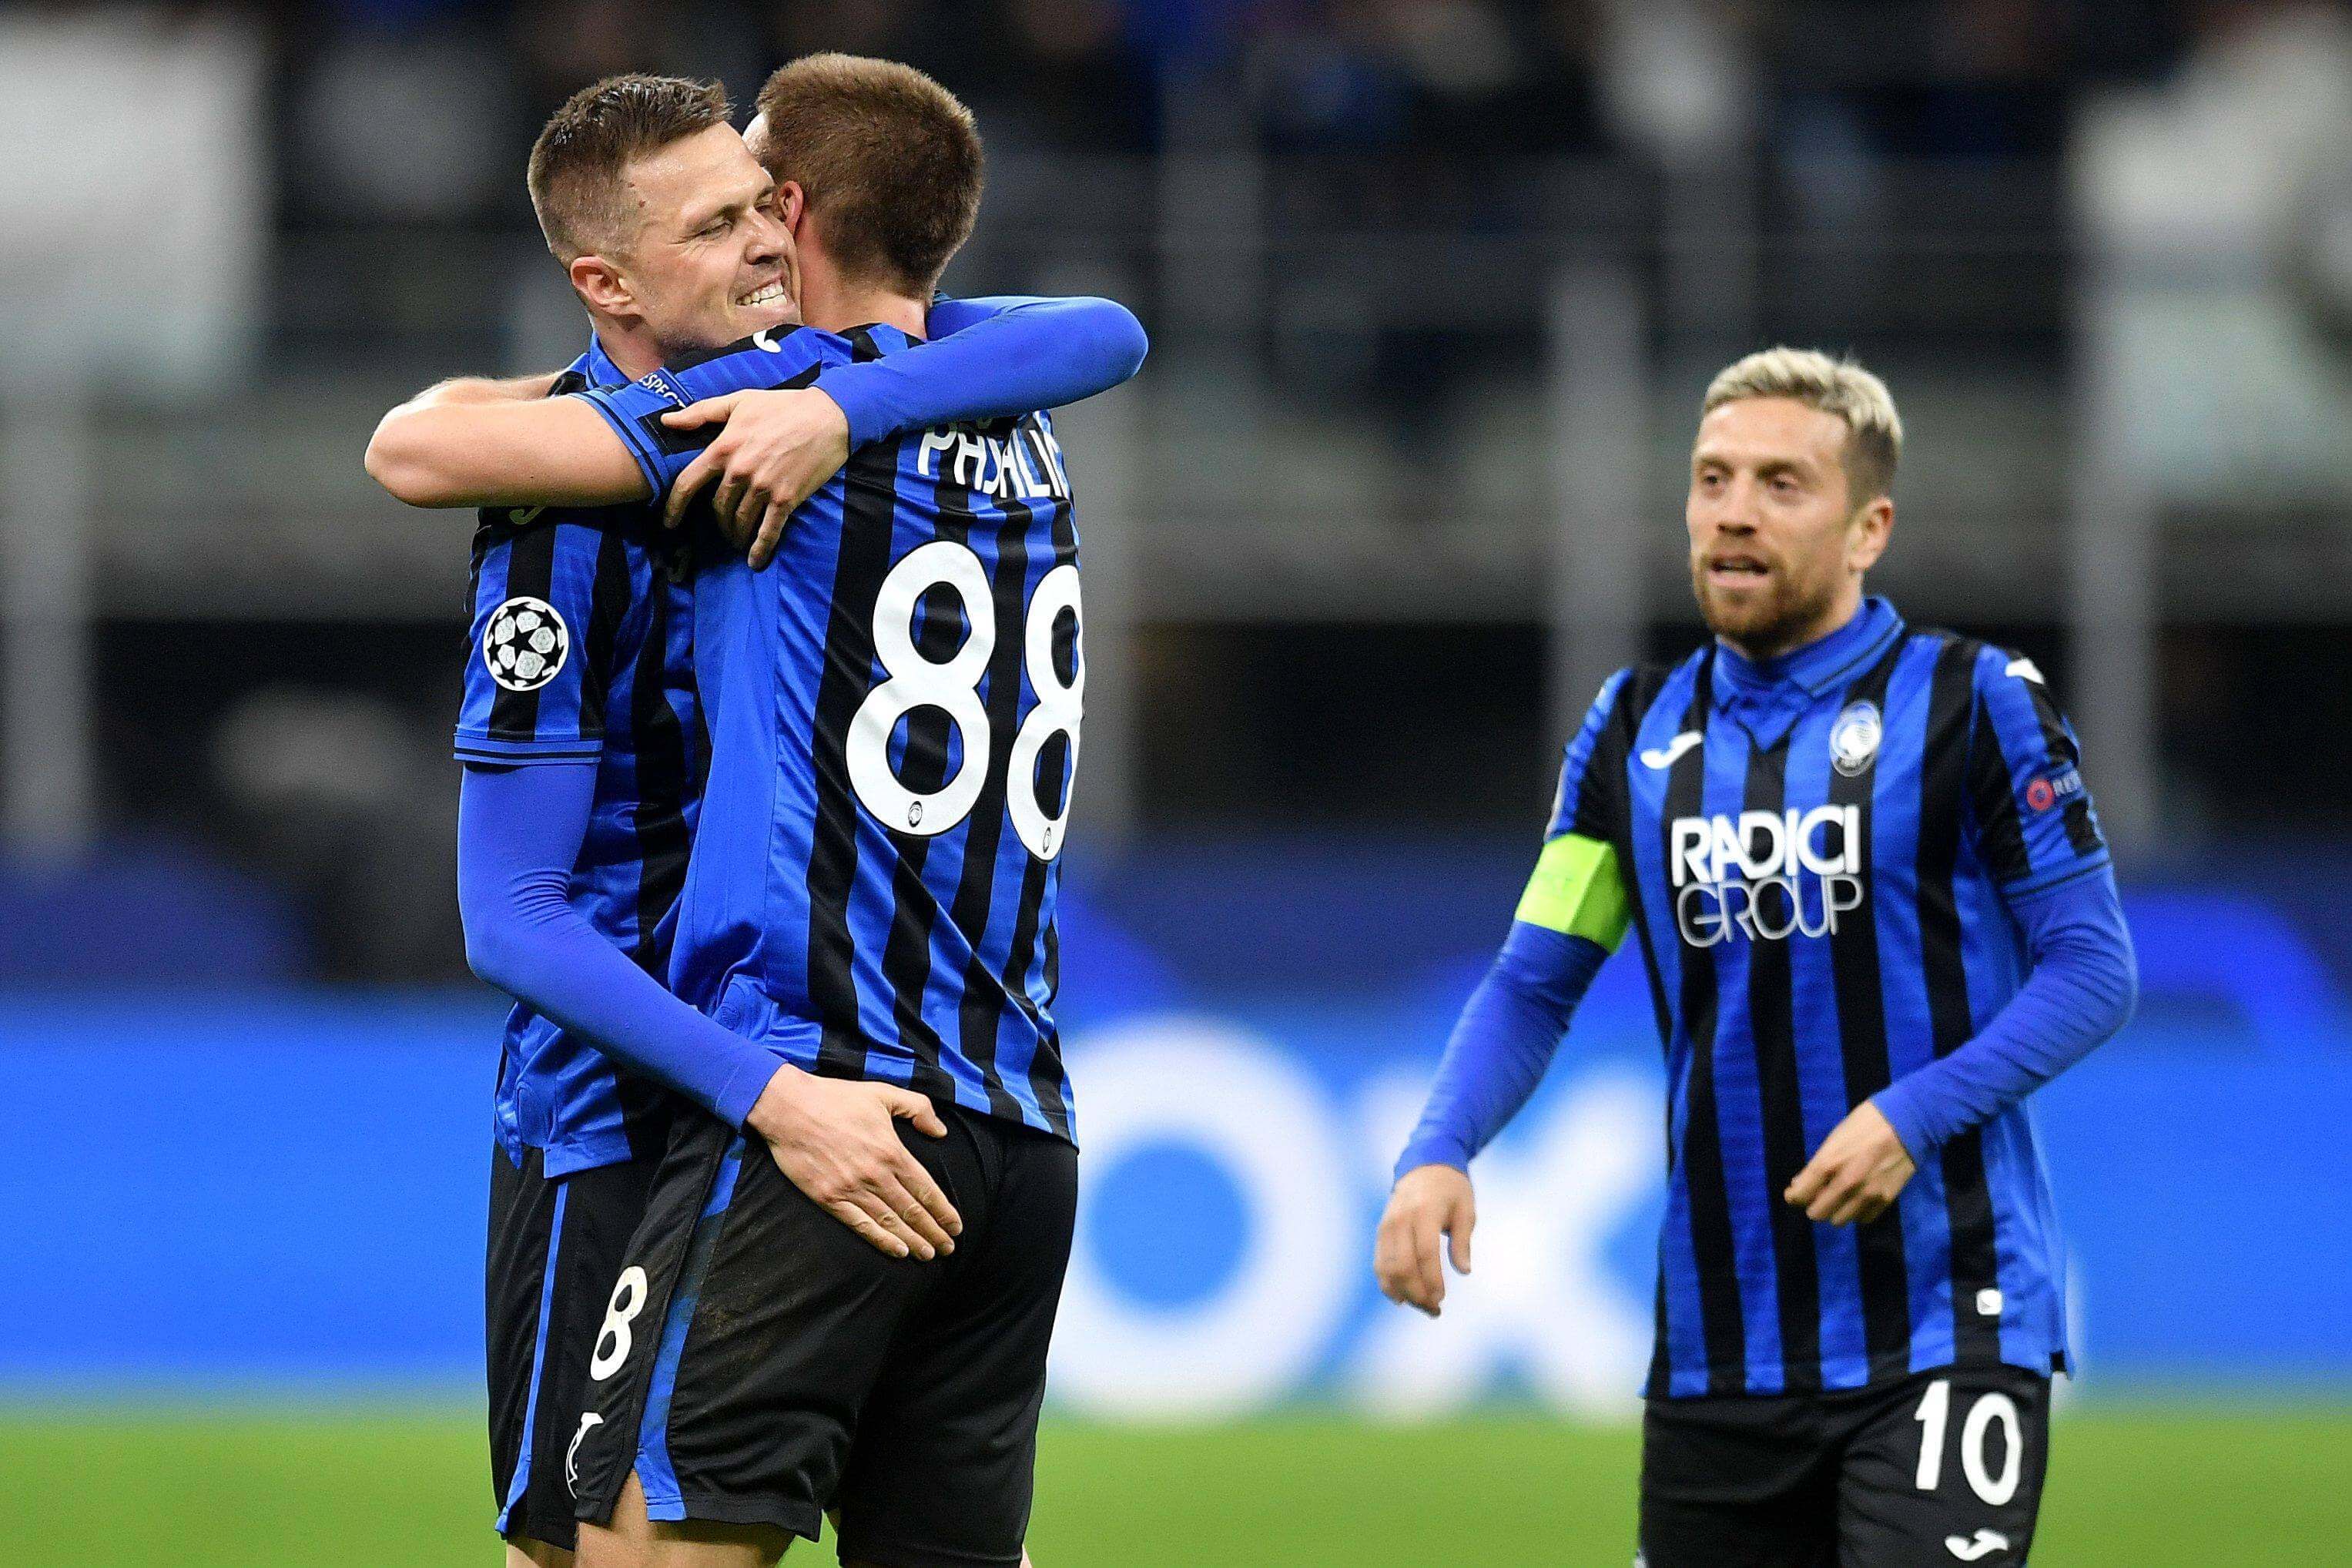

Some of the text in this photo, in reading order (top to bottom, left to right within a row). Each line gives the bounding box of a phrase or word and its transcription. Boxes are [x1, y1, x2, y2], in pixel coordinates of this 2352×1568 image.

[846, 541, 1084, 863] 88
[1670, 804, 1861, 887] RADICI
[1677, 873, 1864, 948] GROUP
[590, 1265, 648, 1381] 8
[1914, 1379, 2023, 1506] 10
